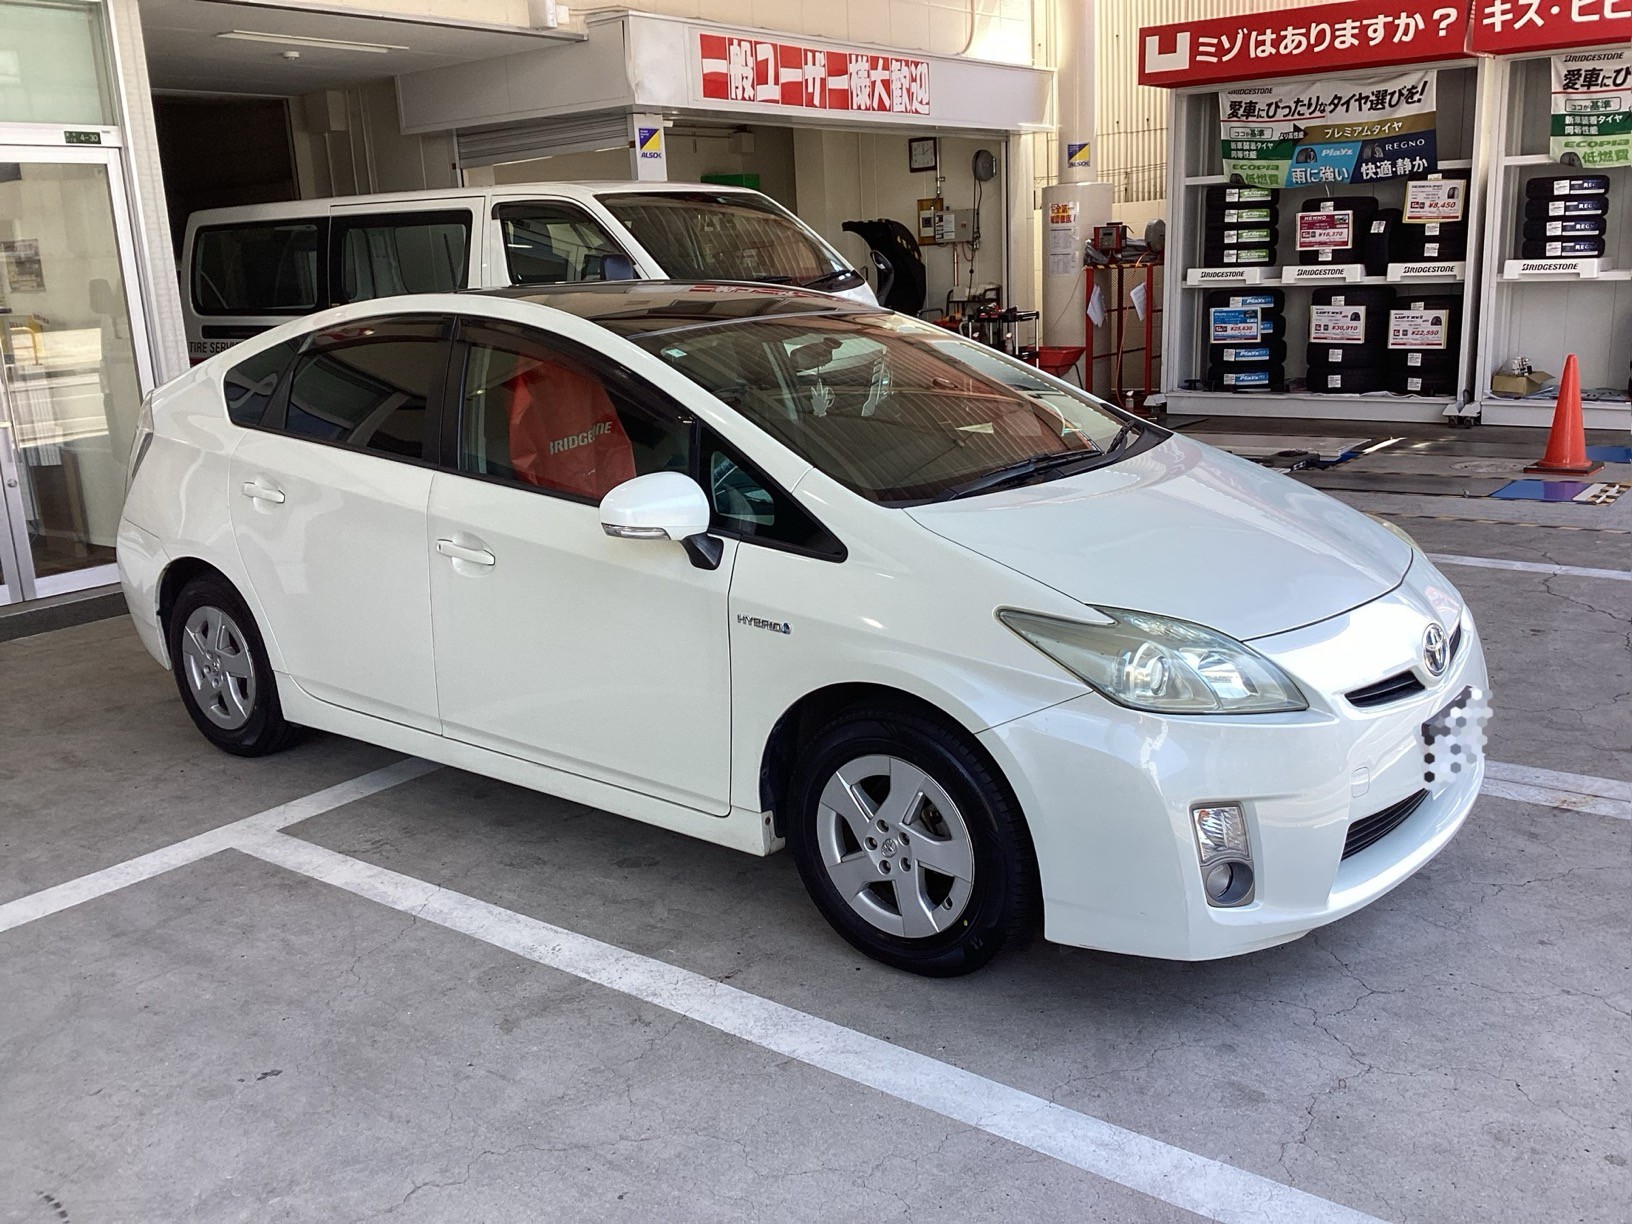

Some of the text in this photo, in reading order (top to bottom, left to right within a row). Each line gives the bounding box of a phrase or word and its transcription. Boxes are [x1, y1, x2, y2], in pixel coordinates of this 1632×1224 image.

[1564, 52, 1625, 62] BRIDGESTONE
[701, 38, 930, 115] 一般ユーザー様大歓迎
[1565, 114, 1623, 124] 新車装着タイヤ
[1323, 121, 1403, 139] プレミアムタイヤ
[1385, 138, 1425, 152] REGNO
[1582, 149, 1629, 163] 低燃費
[1291, 165, 1349, 184] 雨に強い
[1297, 268, 1345, 276] BRIDGESTONE
[1403, 265, 1455, 274] BRIDGESTONE
[1522, 263, 1578, 271] BRIDGESTONE
[1201, 270, 1245, 278] BRIDGESTONE
[189, 341, 208, 353] TIRE
[737, 614, 781, 632] HYBRID
